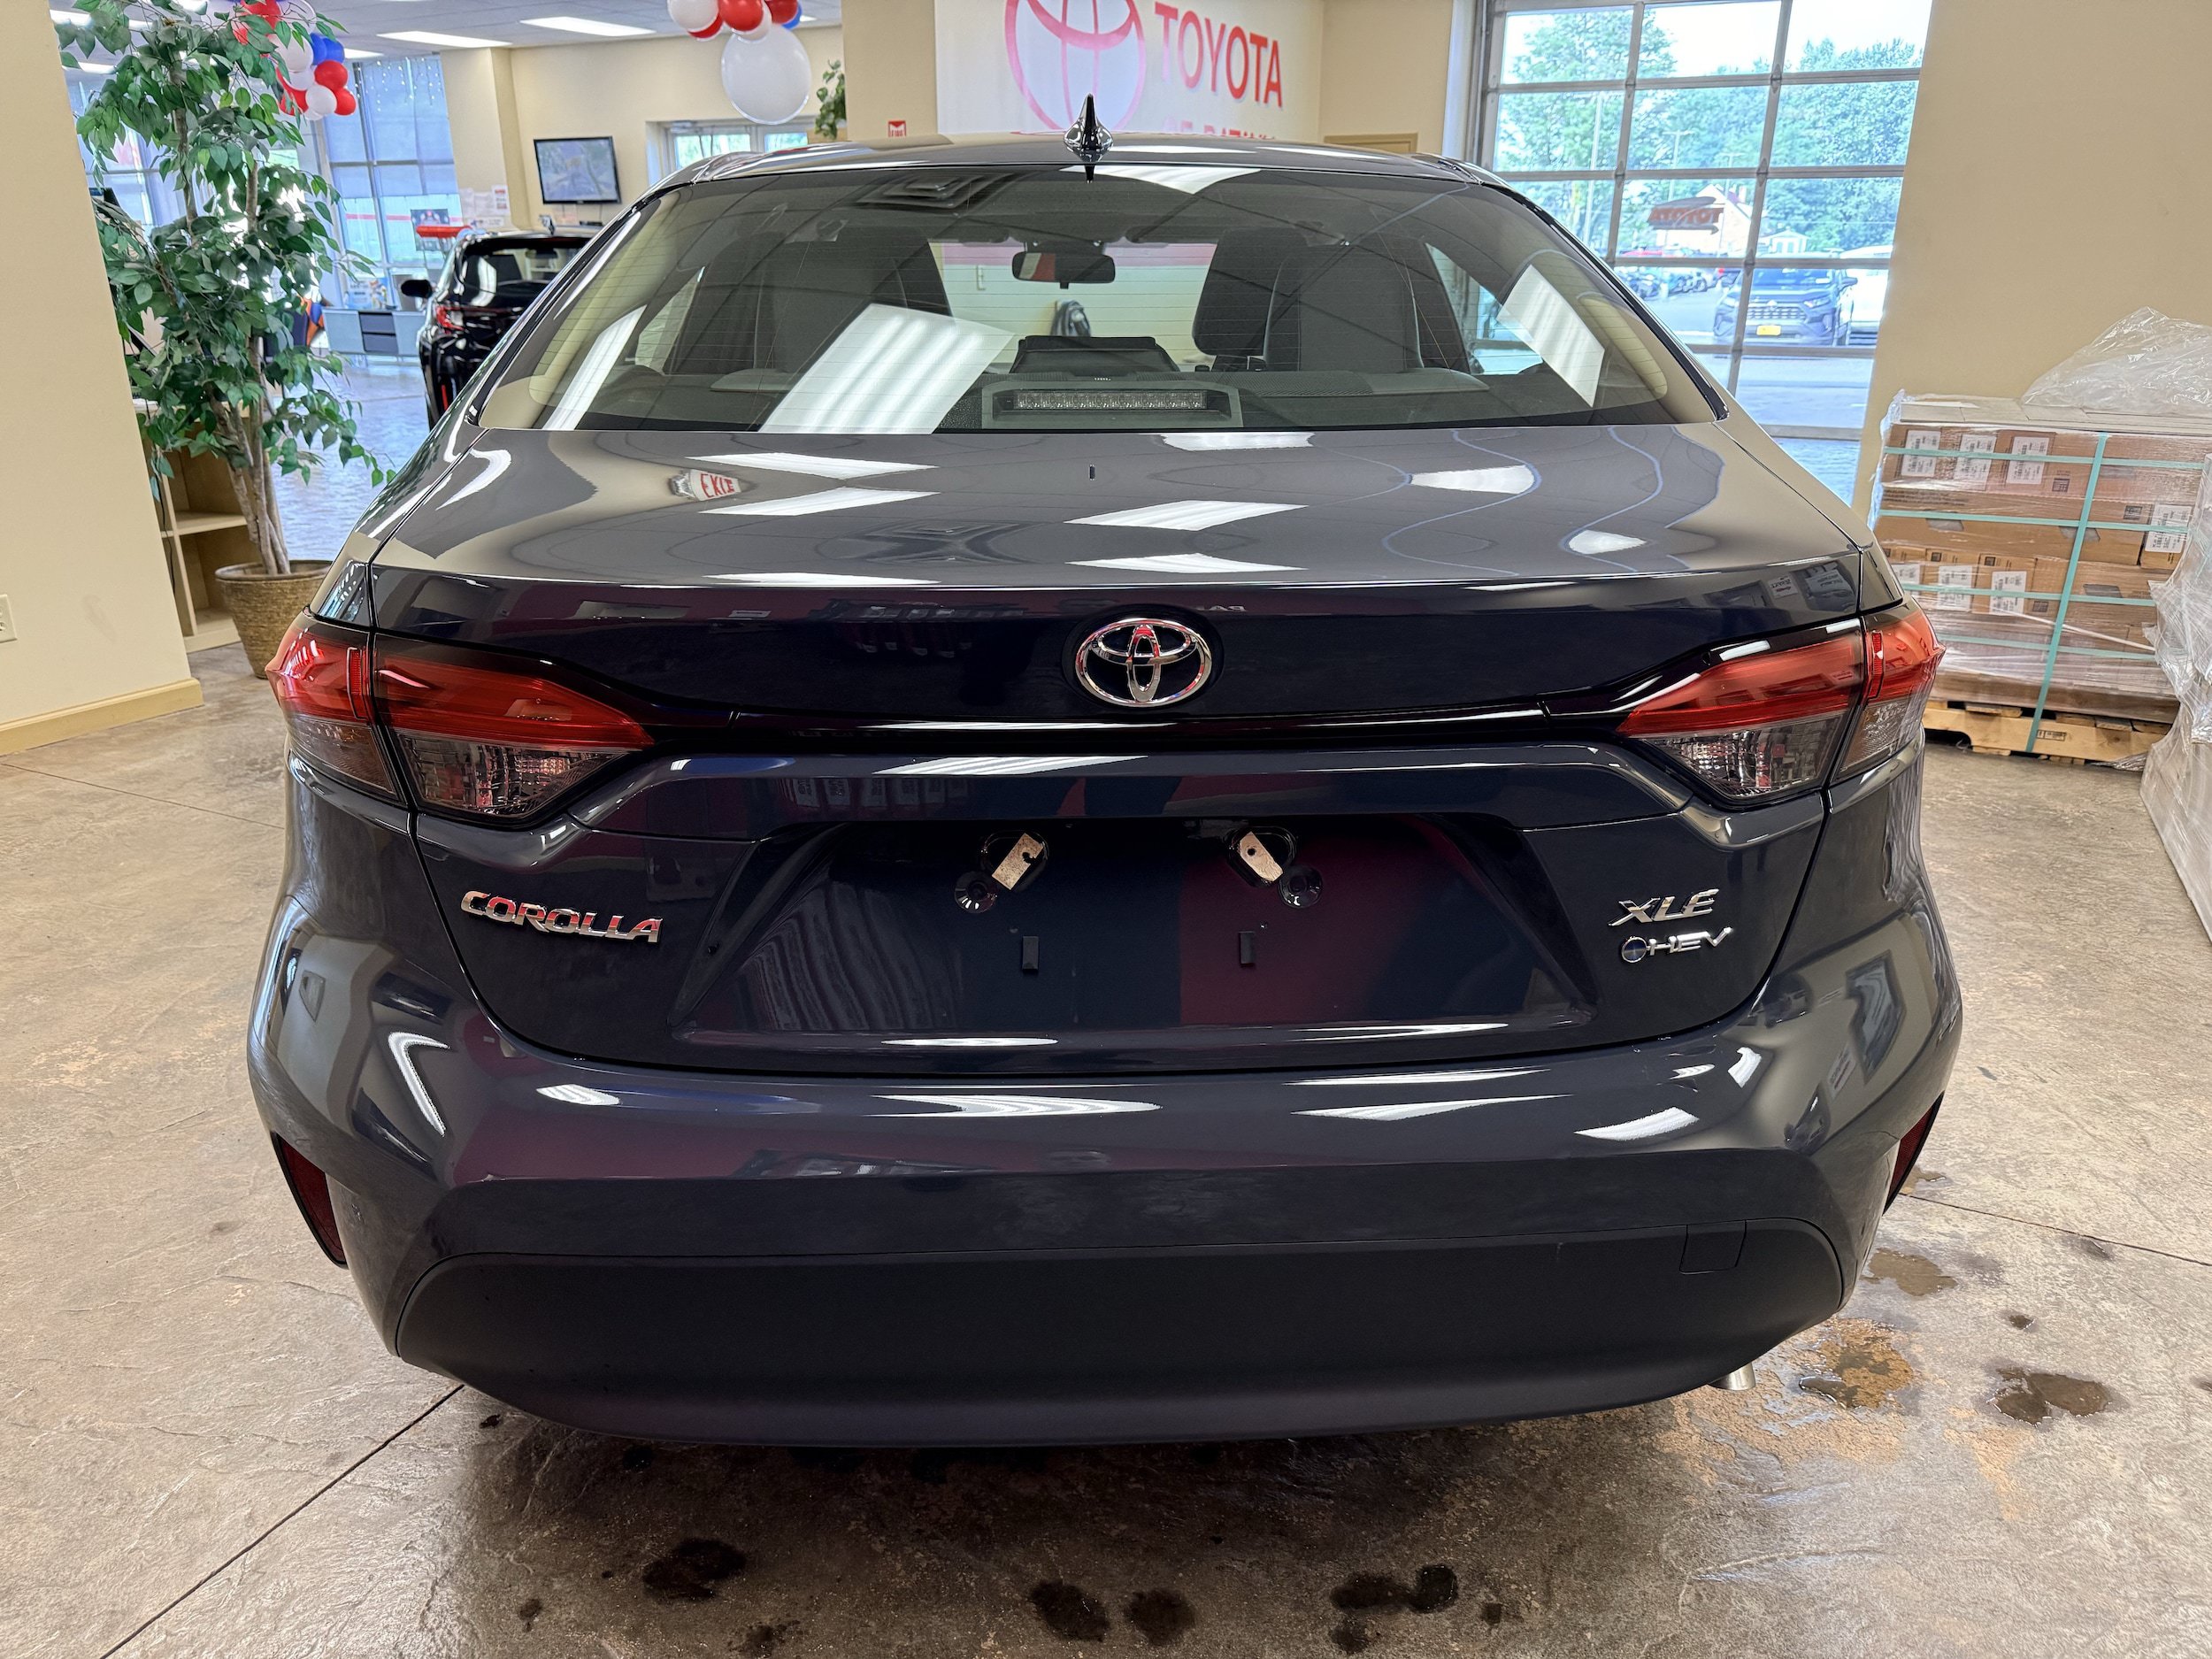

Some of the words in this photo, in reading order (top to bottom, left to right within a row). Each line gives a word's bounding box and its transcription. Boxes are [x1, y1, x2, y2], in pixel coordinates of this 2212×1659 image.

[1154, 1, 1282, 108] TOYOTA
[460, 890, 663, 943] COROLLA
[1608, 888, 1719, 926] XLE
